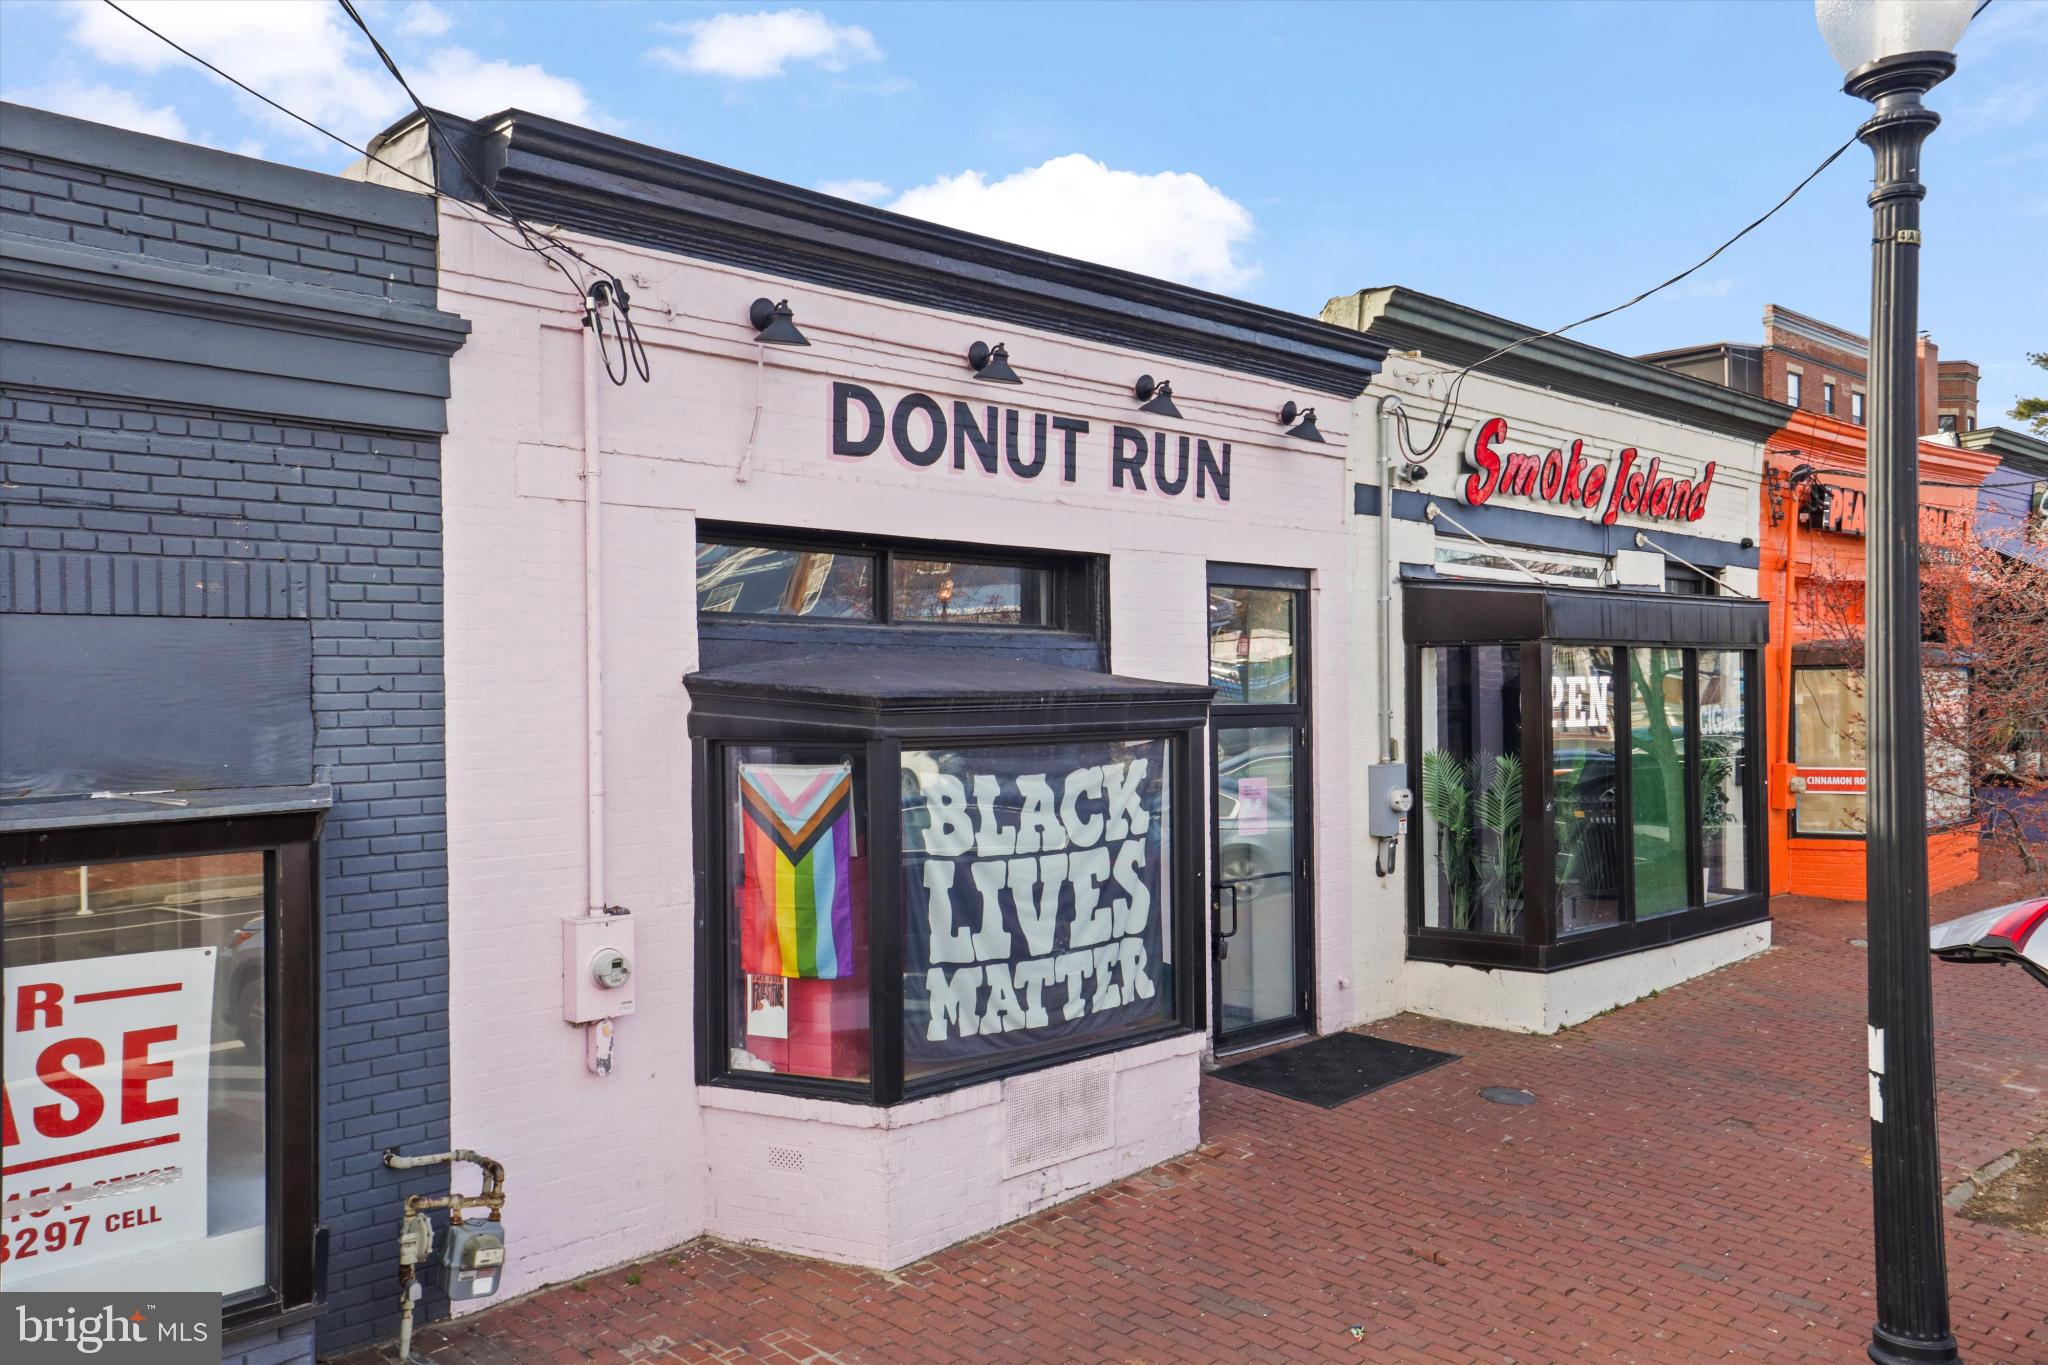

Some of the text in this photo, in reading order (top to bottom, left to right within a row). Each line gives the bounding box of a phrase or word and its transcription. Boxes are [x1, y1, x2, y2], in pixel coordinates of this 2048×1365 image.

[830, 381, 1232, 502] DONUT RUN
[1463, 417, 1717, 526] Smoke Island
[1550, 675, 1611, 728] PEN
[919, 758, 1151, 858] BLACK
[1807, 776, 1852, 785] CINNAMON
[923, 837, 1151, 965] LIVES
[925, 936, 1156, 1042] MATTER
[104, 1205, 162, 1233] CELL
